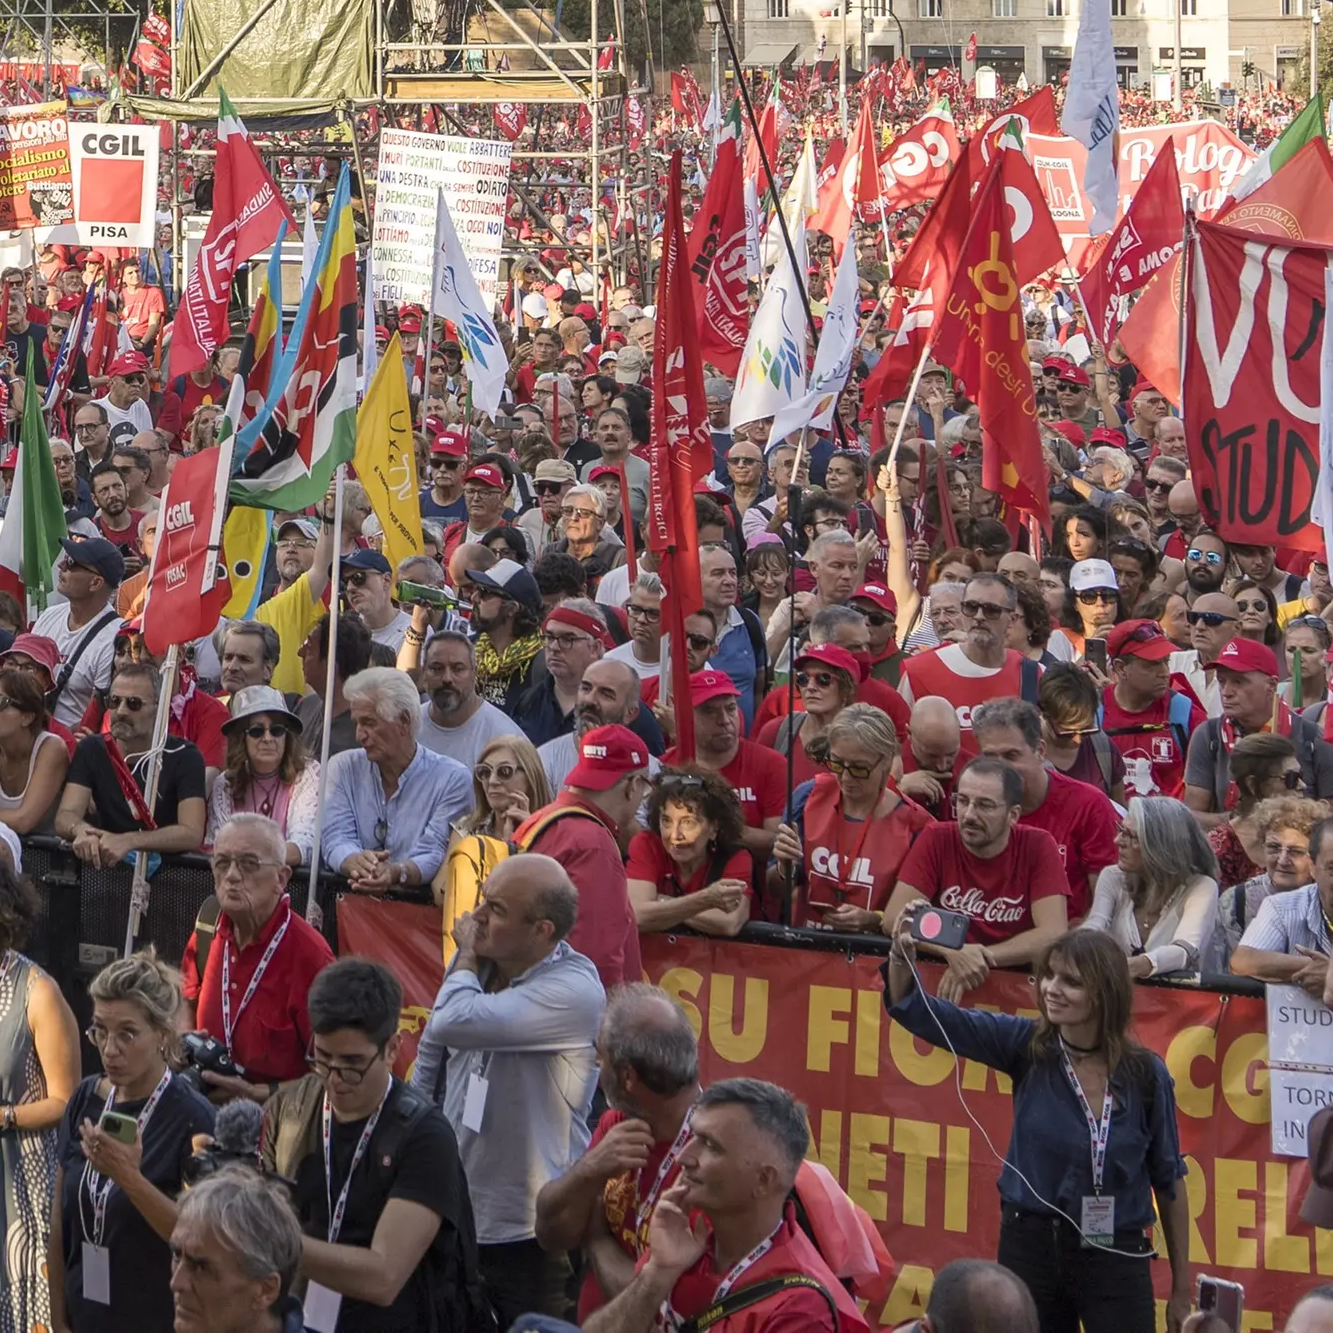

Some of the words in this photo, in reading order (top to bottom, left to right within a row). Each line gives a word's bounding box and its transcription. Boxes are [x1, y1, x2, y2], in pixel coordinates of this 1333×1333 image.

[82, 133, 145, 156] CGIL
[382, 131, 411, 146] QUESTO
[411, 136, 446, 152] GOVERNO
[446, 140, 467, 154] VUOLE
[469, 141, 512, 159] ABBATTERE
[59, 158, 71, 175] al
[384, 151, 404, 166] MURI
[405, 154, 443, 171] PORTANTI
[456, 159, 510, 178] COSTITUZIONE
[26, 180, 72, 191] Buttiamo
[379, 169, 397, 185] UNA
[398, 172, 429, 190] DESTRA
[453, 182, 475, 194] SEMPRE
[476, 179, 508, 197] ODIATO
[385, 190, 435, 210] DEMOCRAZIA
[455, 198, 506, 217] COSTITUZIONE
[90, 226, 128, 238] PISA
[382, 208, 417, 226] PRINCIPIO
[466, 219, 485, 234] OGGI
[486, 221, 502, 237] NOI
[374, 226, 409, 244] LOTTIAMO
[373, 246, 413, 263] CONNESSA
[381, 283, 404, 300] FIGLI
[650, 442, 668, 540] METALLURGICI
[166, 500, 195, 531] CGIL
[166, 565, 187, 588] FISAC
[940, 885, 987, 914] Bella
[983, 895, 1025, 922] Ciao
[658, 967, 769, 1064] SU
[1283, 1121, 1305, 1139] IN
[697, 1305, 723, 1329] Nikon
